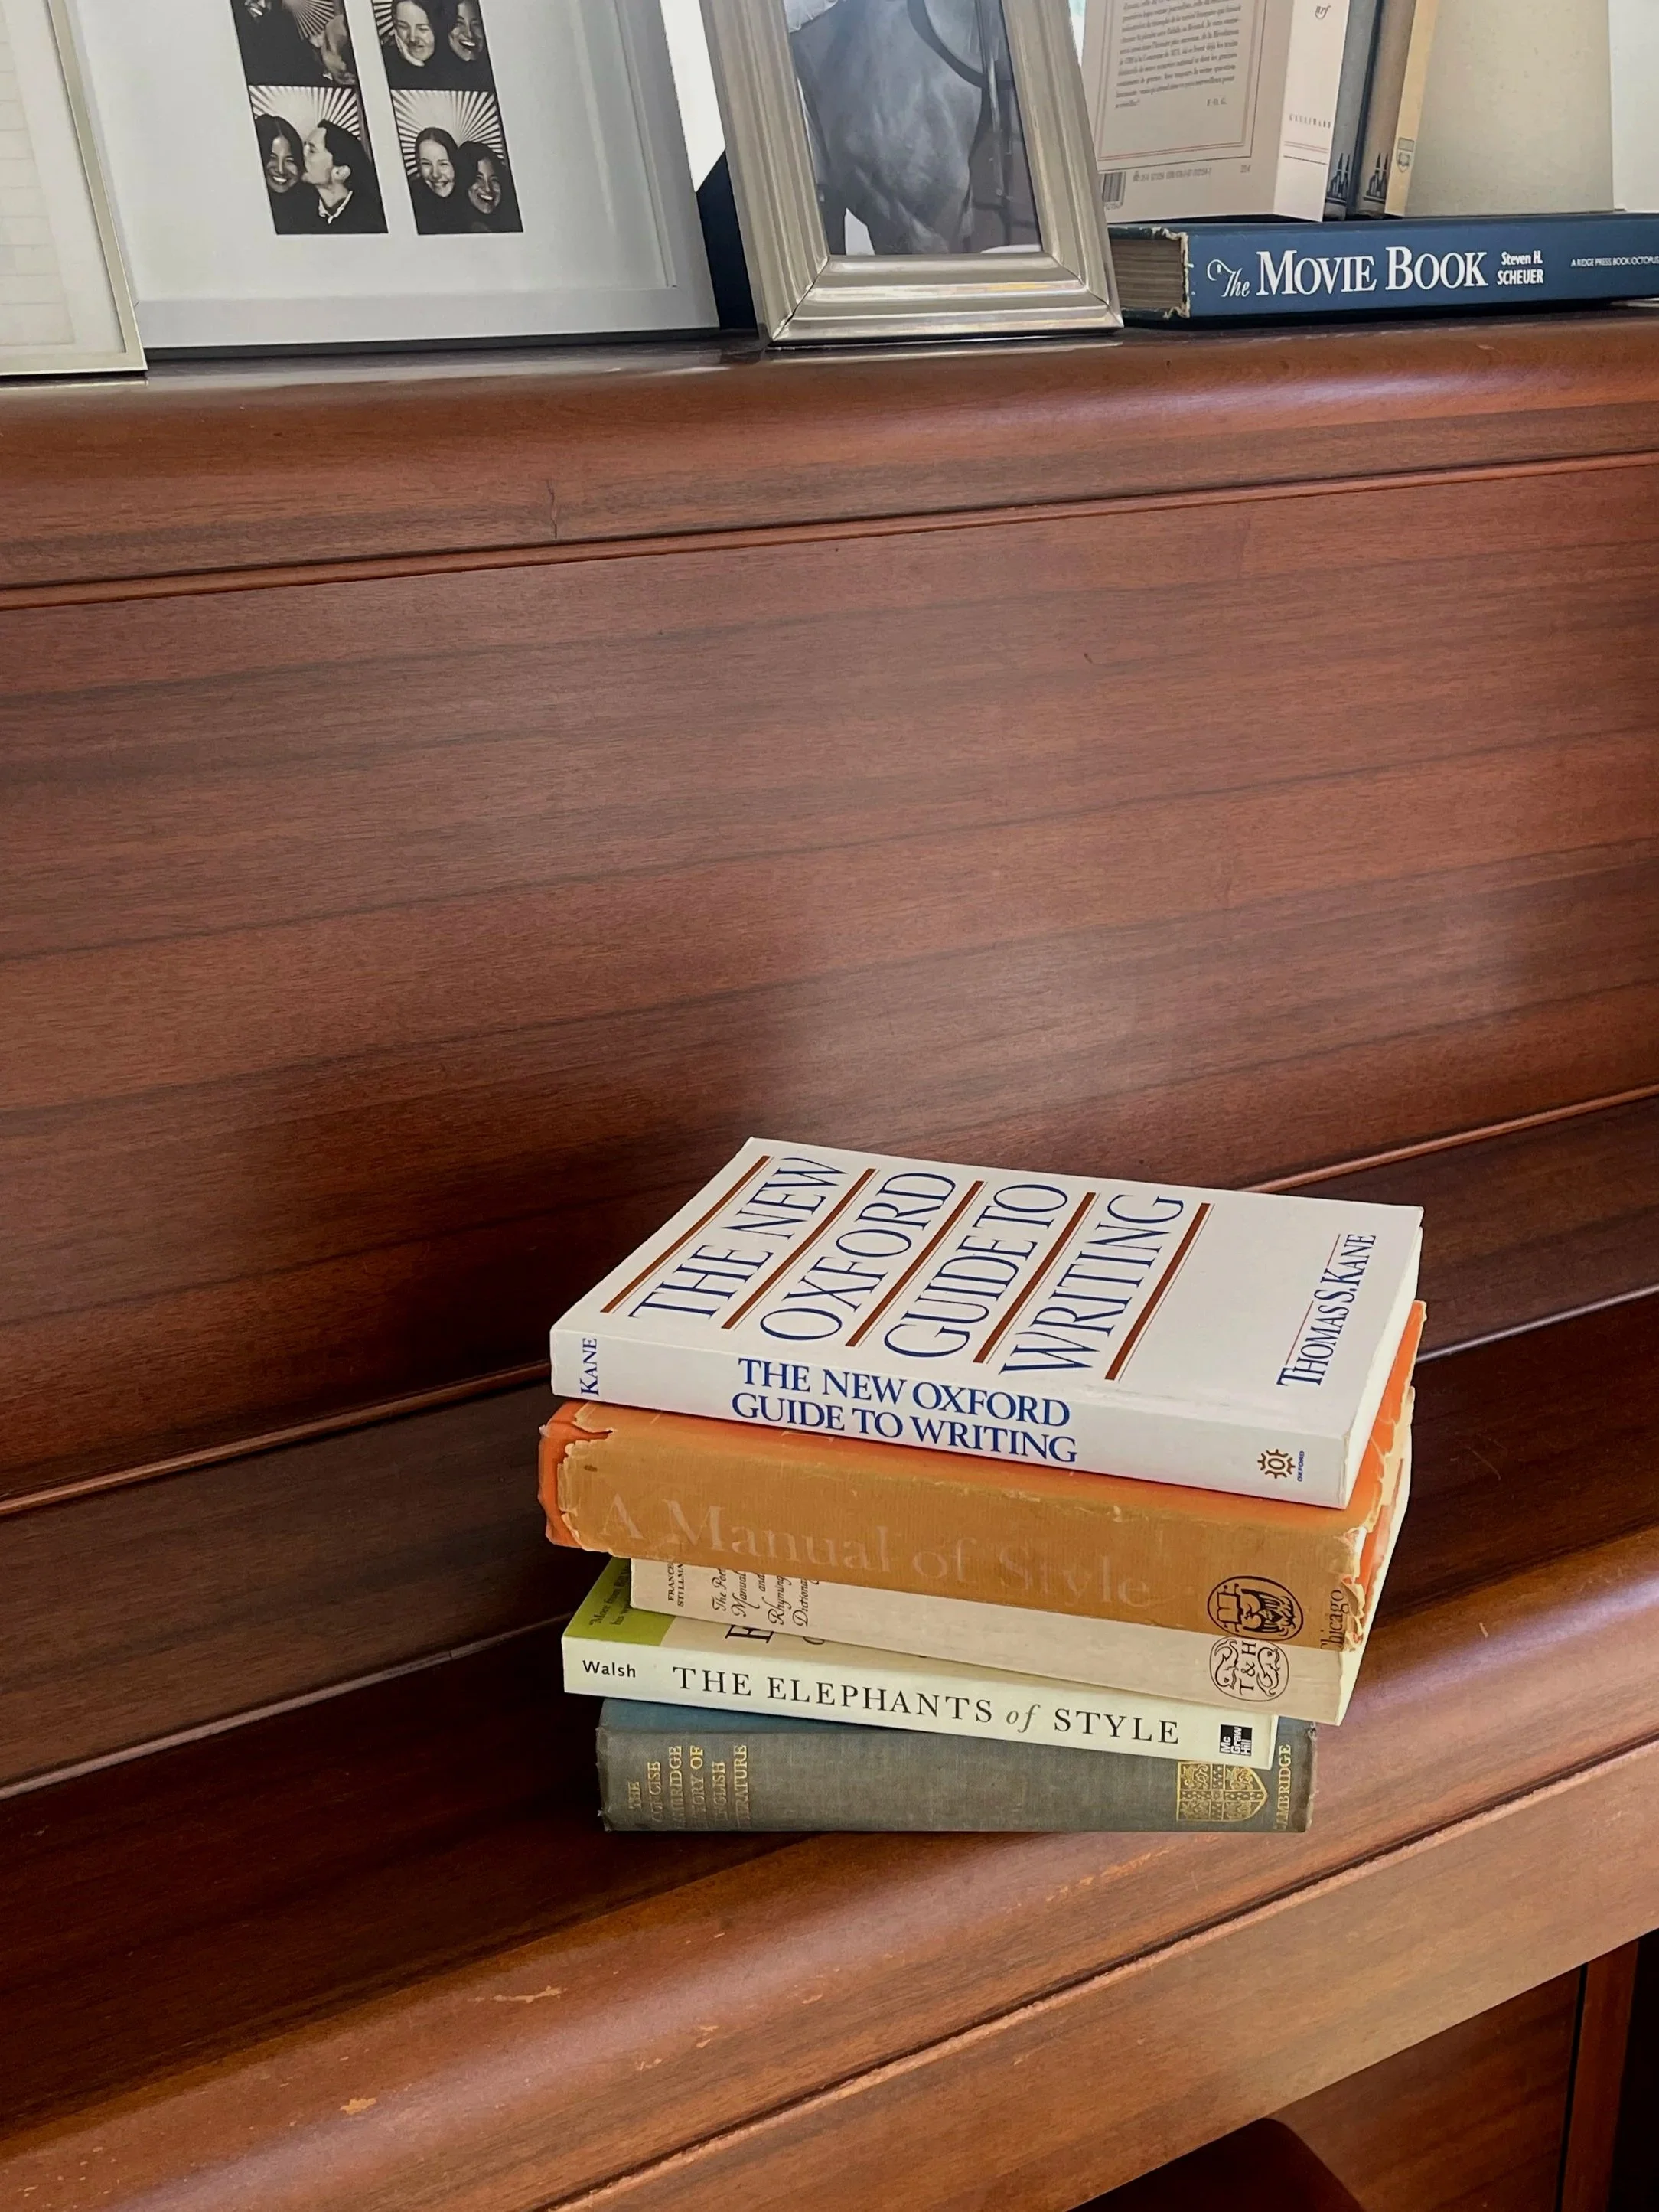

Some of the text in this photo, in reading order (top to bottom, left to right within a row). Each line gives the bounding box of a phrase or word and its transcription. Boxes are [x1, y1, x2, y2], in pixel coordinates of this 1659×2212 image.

[1207, 246, 1488, 298] The MOVIE BOOK
[1497, 269, 1544, 285] SCHEUER
[1501, 251, 1531, 266] Steven
[627, 1157, 847, 1320] THE NEW
[760, 1173, 956, 1340] OXFORD
[884, 1184, 1068, 1358] GUIDE TO
[999, 1194, 1184, 1375] WRITING
[1276, 1304, 1349, 1386] THOMAS
[1320, 1234, 1377, 1287] KANE
[579, 1338, 599, 1396] KANE
[738, 1358, 1071, 1427] THE NEW OXFORD
[732, 1392, 1077, 1463] GUIDE TO WRITING
[599, 1493, 1150, 1607] A Manual of Style
[712, 1592, 727, 1611] The
[732, 1570, 760, 1617] Manual
[755, 1572, 766, 1592] and
[762, 1575, 792, 1626] Rhyming
[582, 1660, 636, 1678] Walsh
[1239, 1641, 1256, 1695] T & H
[673, 1666, 1180, 1745] THE ELEPHANTS of STYLE
[689, 1745, 703, 1770] OF
[1220, 1735, 1231, 1753] Mc
[1230, 1726, 1242, 1754] Graw
[1240, 1739, 1252, 1755] Hill
[627, 1781, 641, 1809] THE
